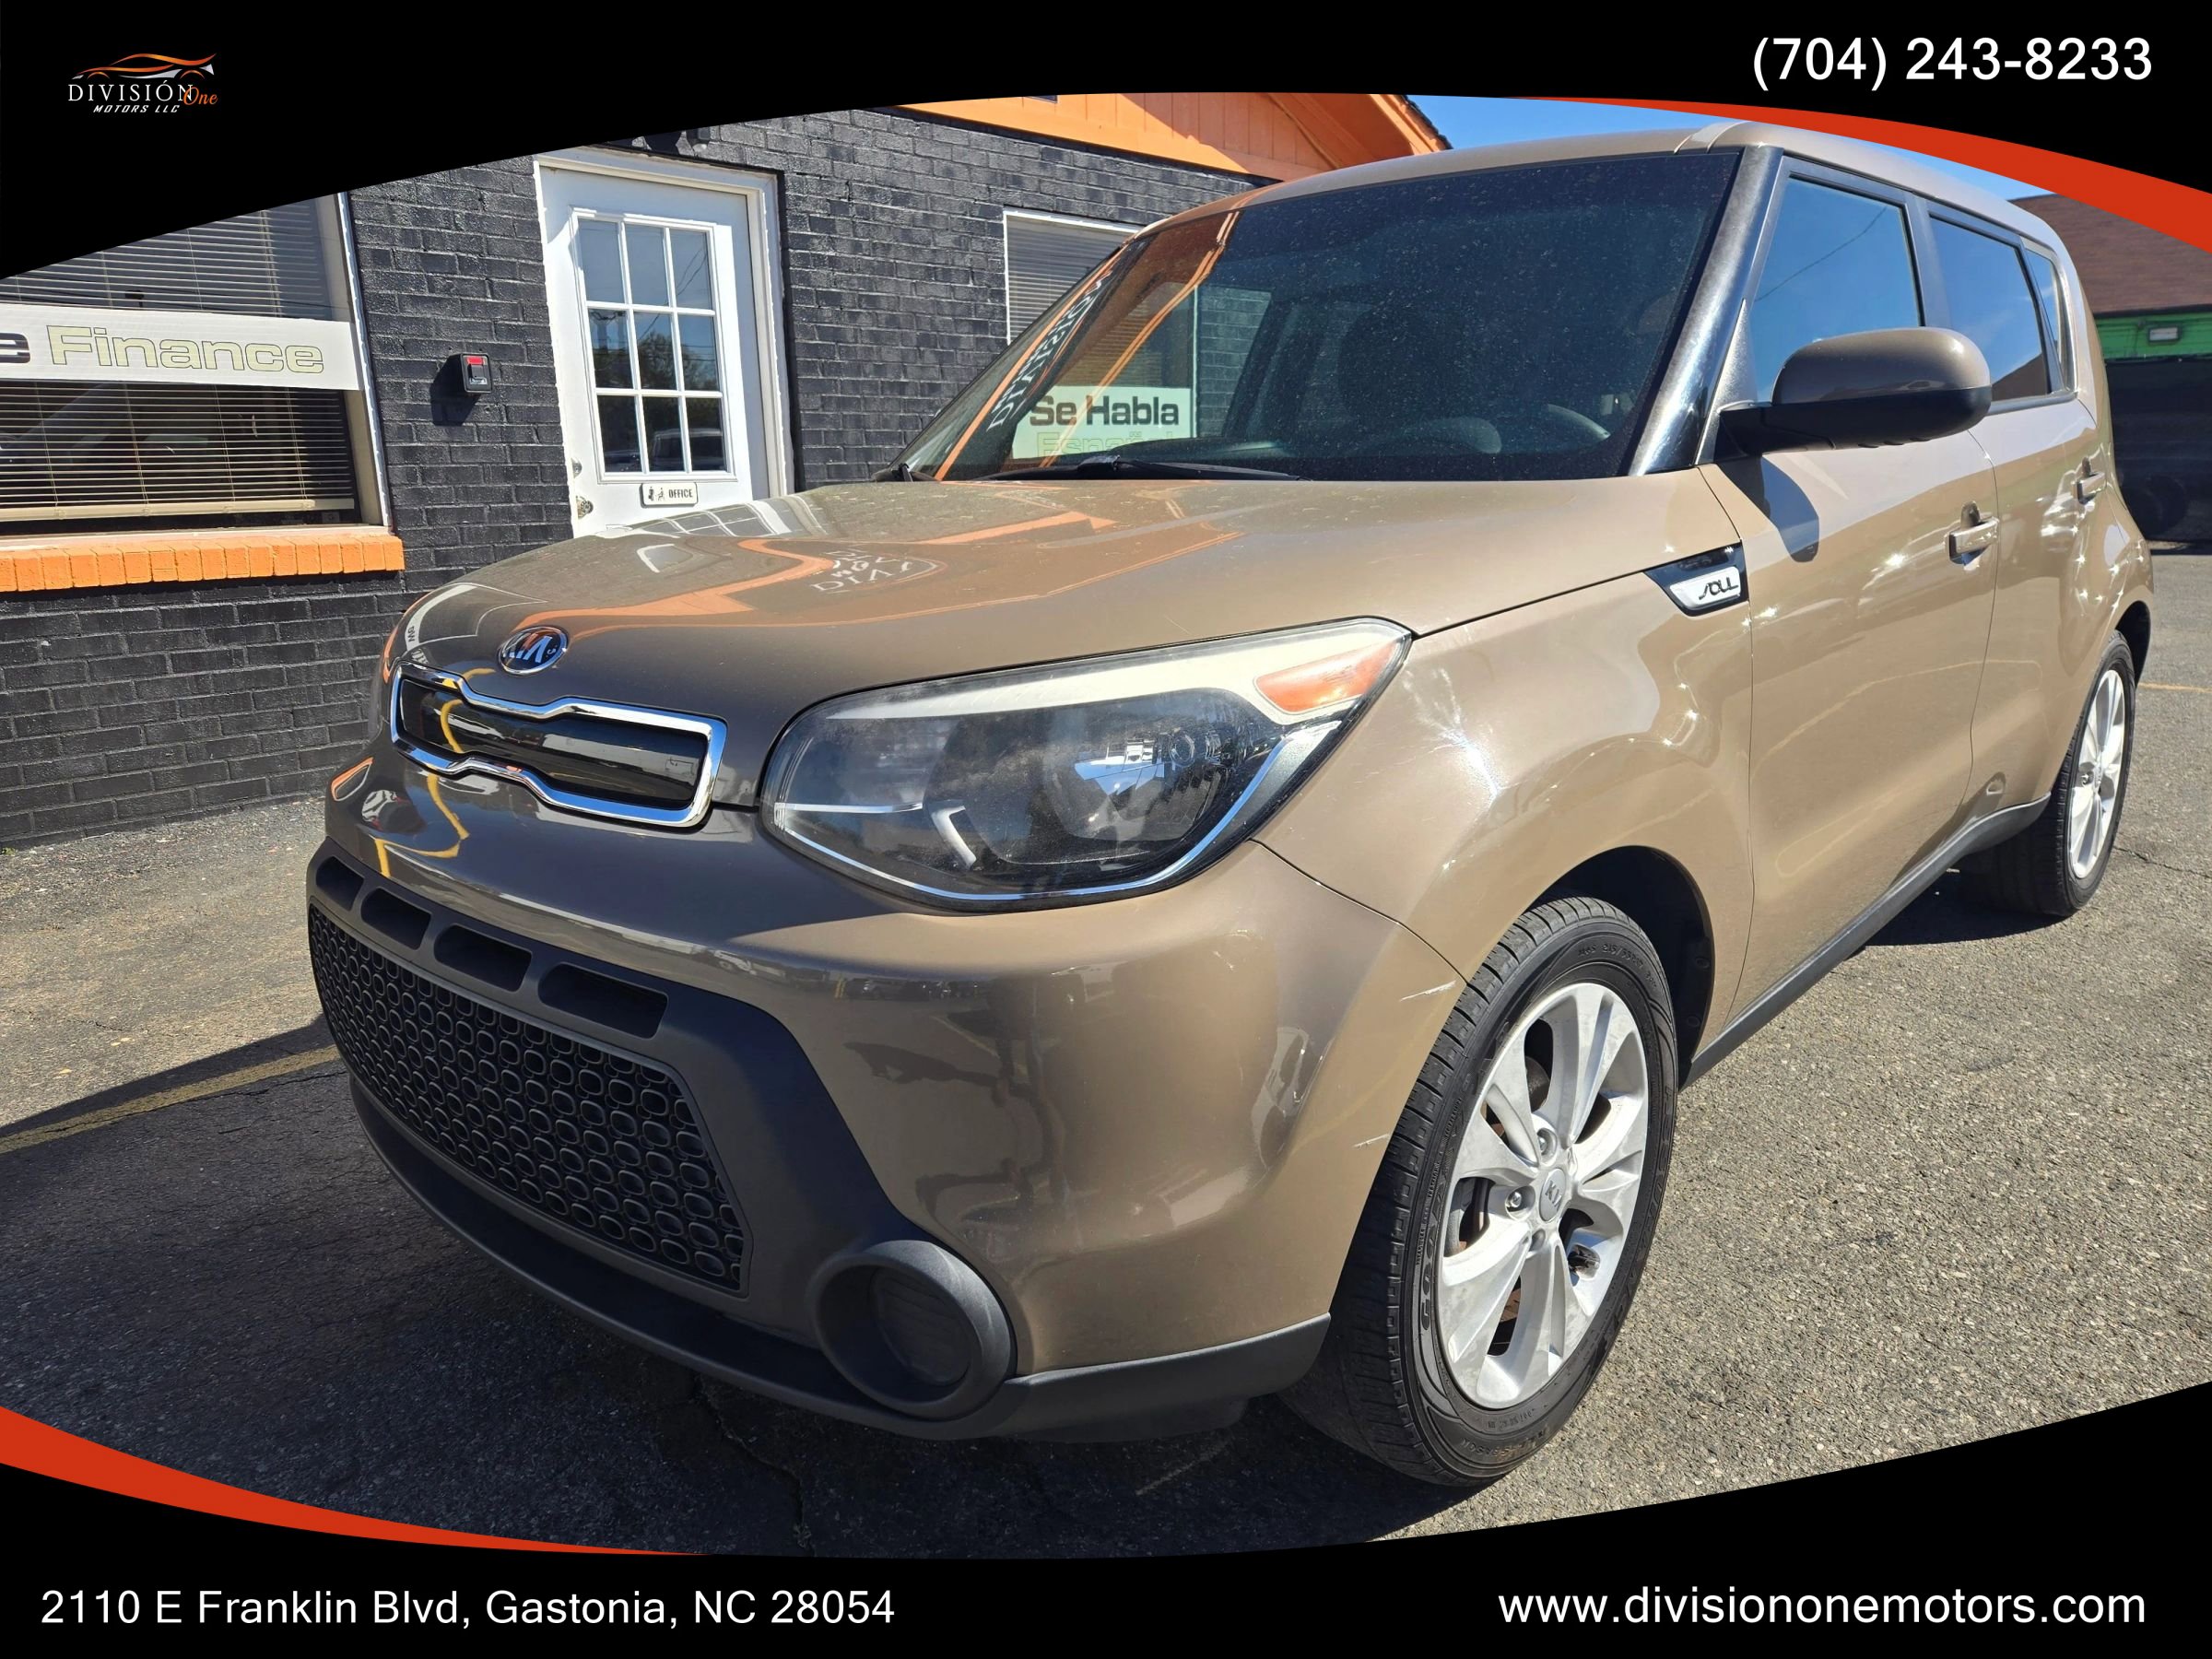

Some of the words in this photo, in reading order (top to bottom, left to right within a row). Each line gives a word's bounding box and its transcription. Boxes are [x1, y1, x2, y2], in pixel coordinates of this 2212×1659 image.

[46, 324, 324, 373] Finance
[1030, 395, 1077, 426] Se
[1086, 395, 1180, 426] Habla
[668, 488, 693, 499] OFFICE
[1545, 1180, 1563, 1211] KIA
